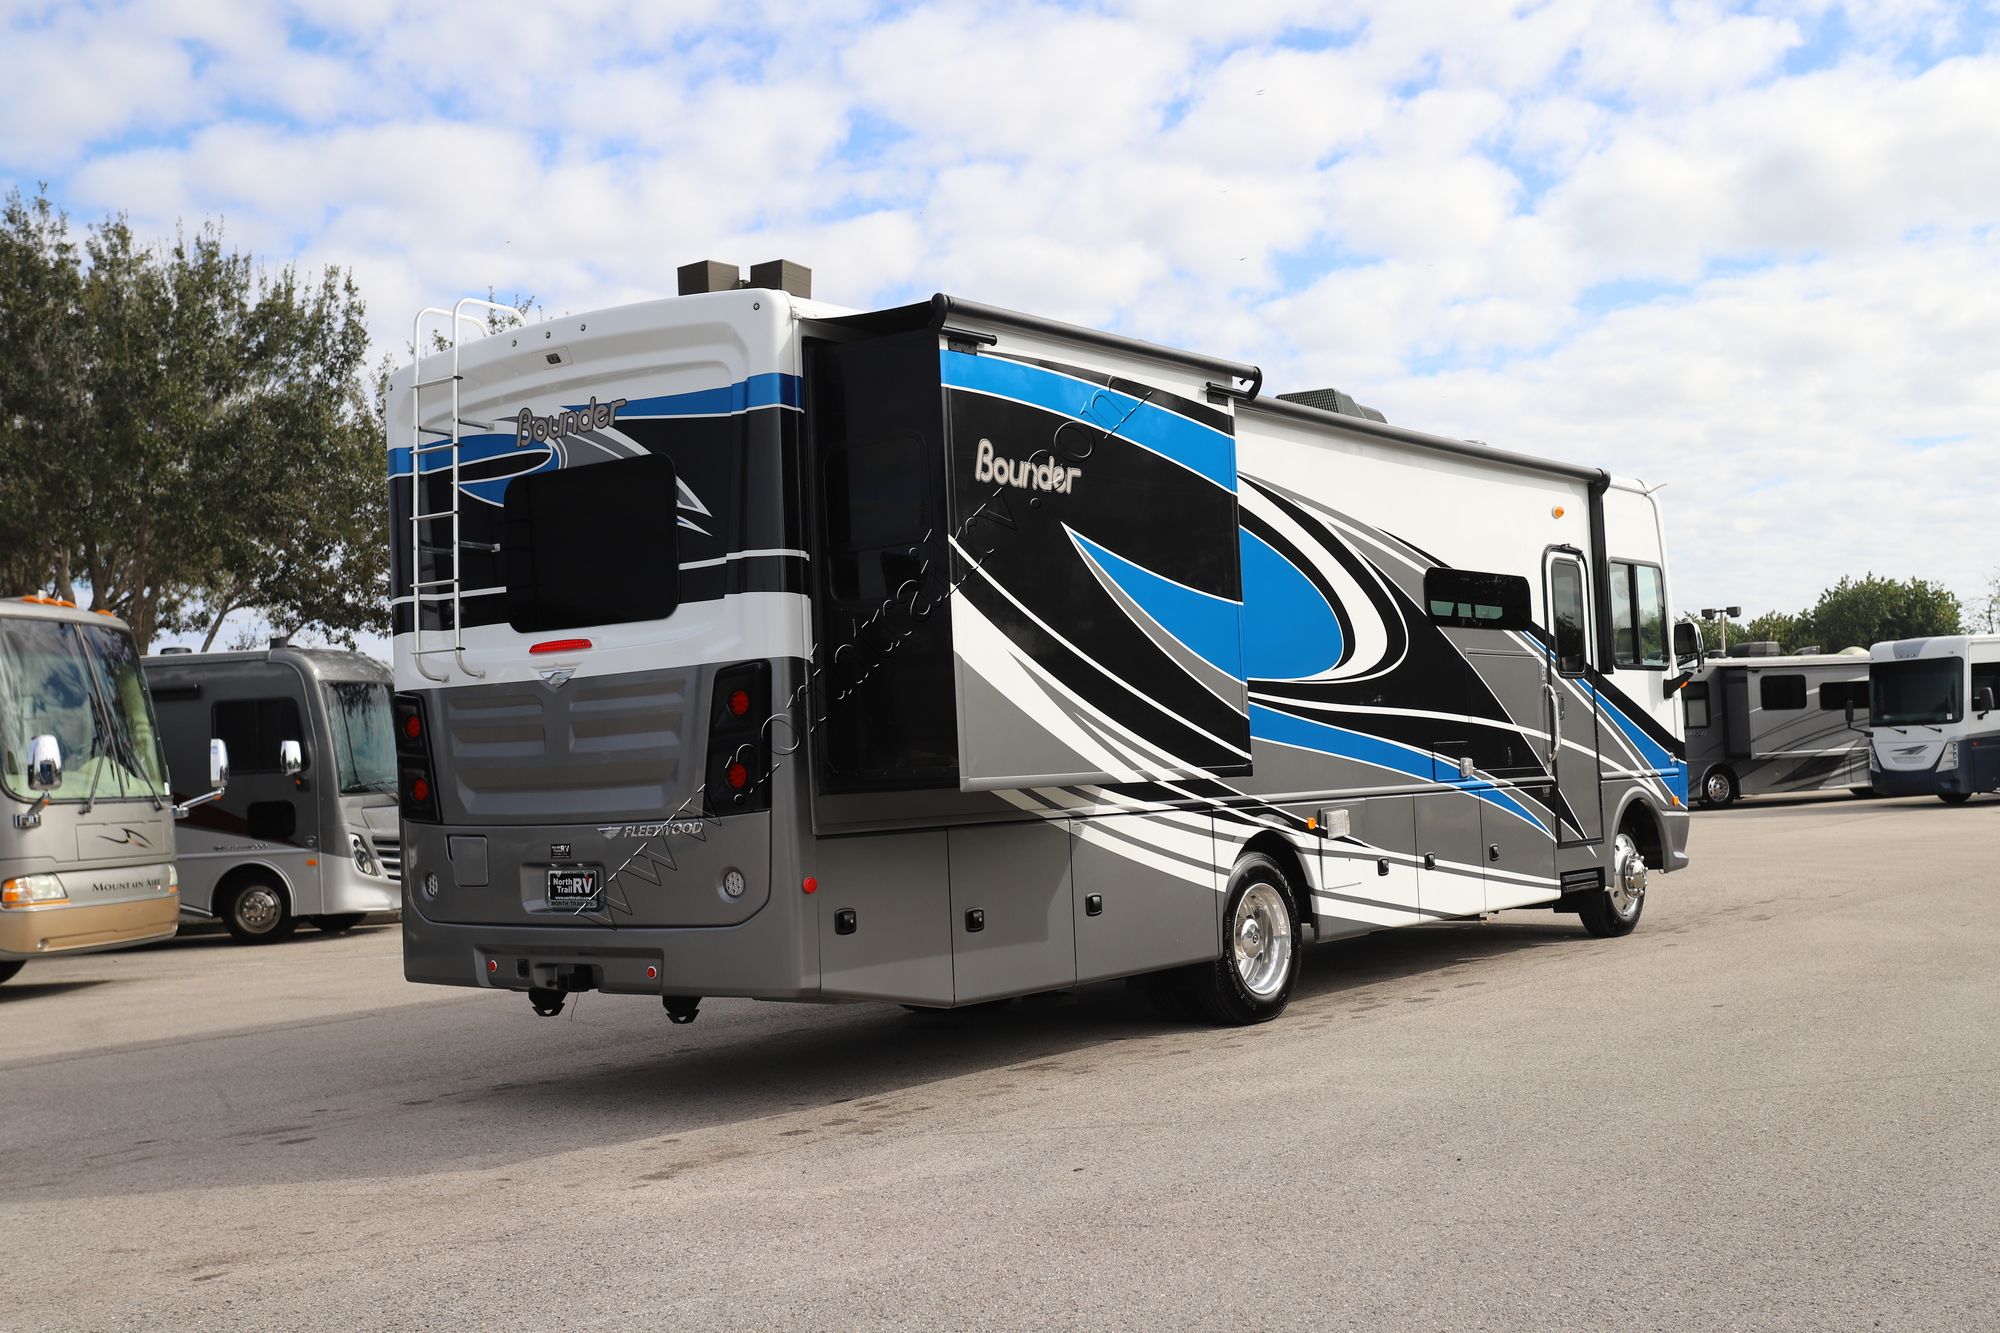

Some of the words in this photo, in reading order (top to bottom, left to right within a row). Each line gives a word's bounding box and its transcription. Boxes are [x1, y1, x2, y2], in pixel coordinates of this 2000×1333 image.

[516, 396, 627, 448] Bounder
[975, 438, 1082, 494] Bounder
[624, 822, 703, 838] FLEETWOOD
[573, 878, 593, 893] RV
